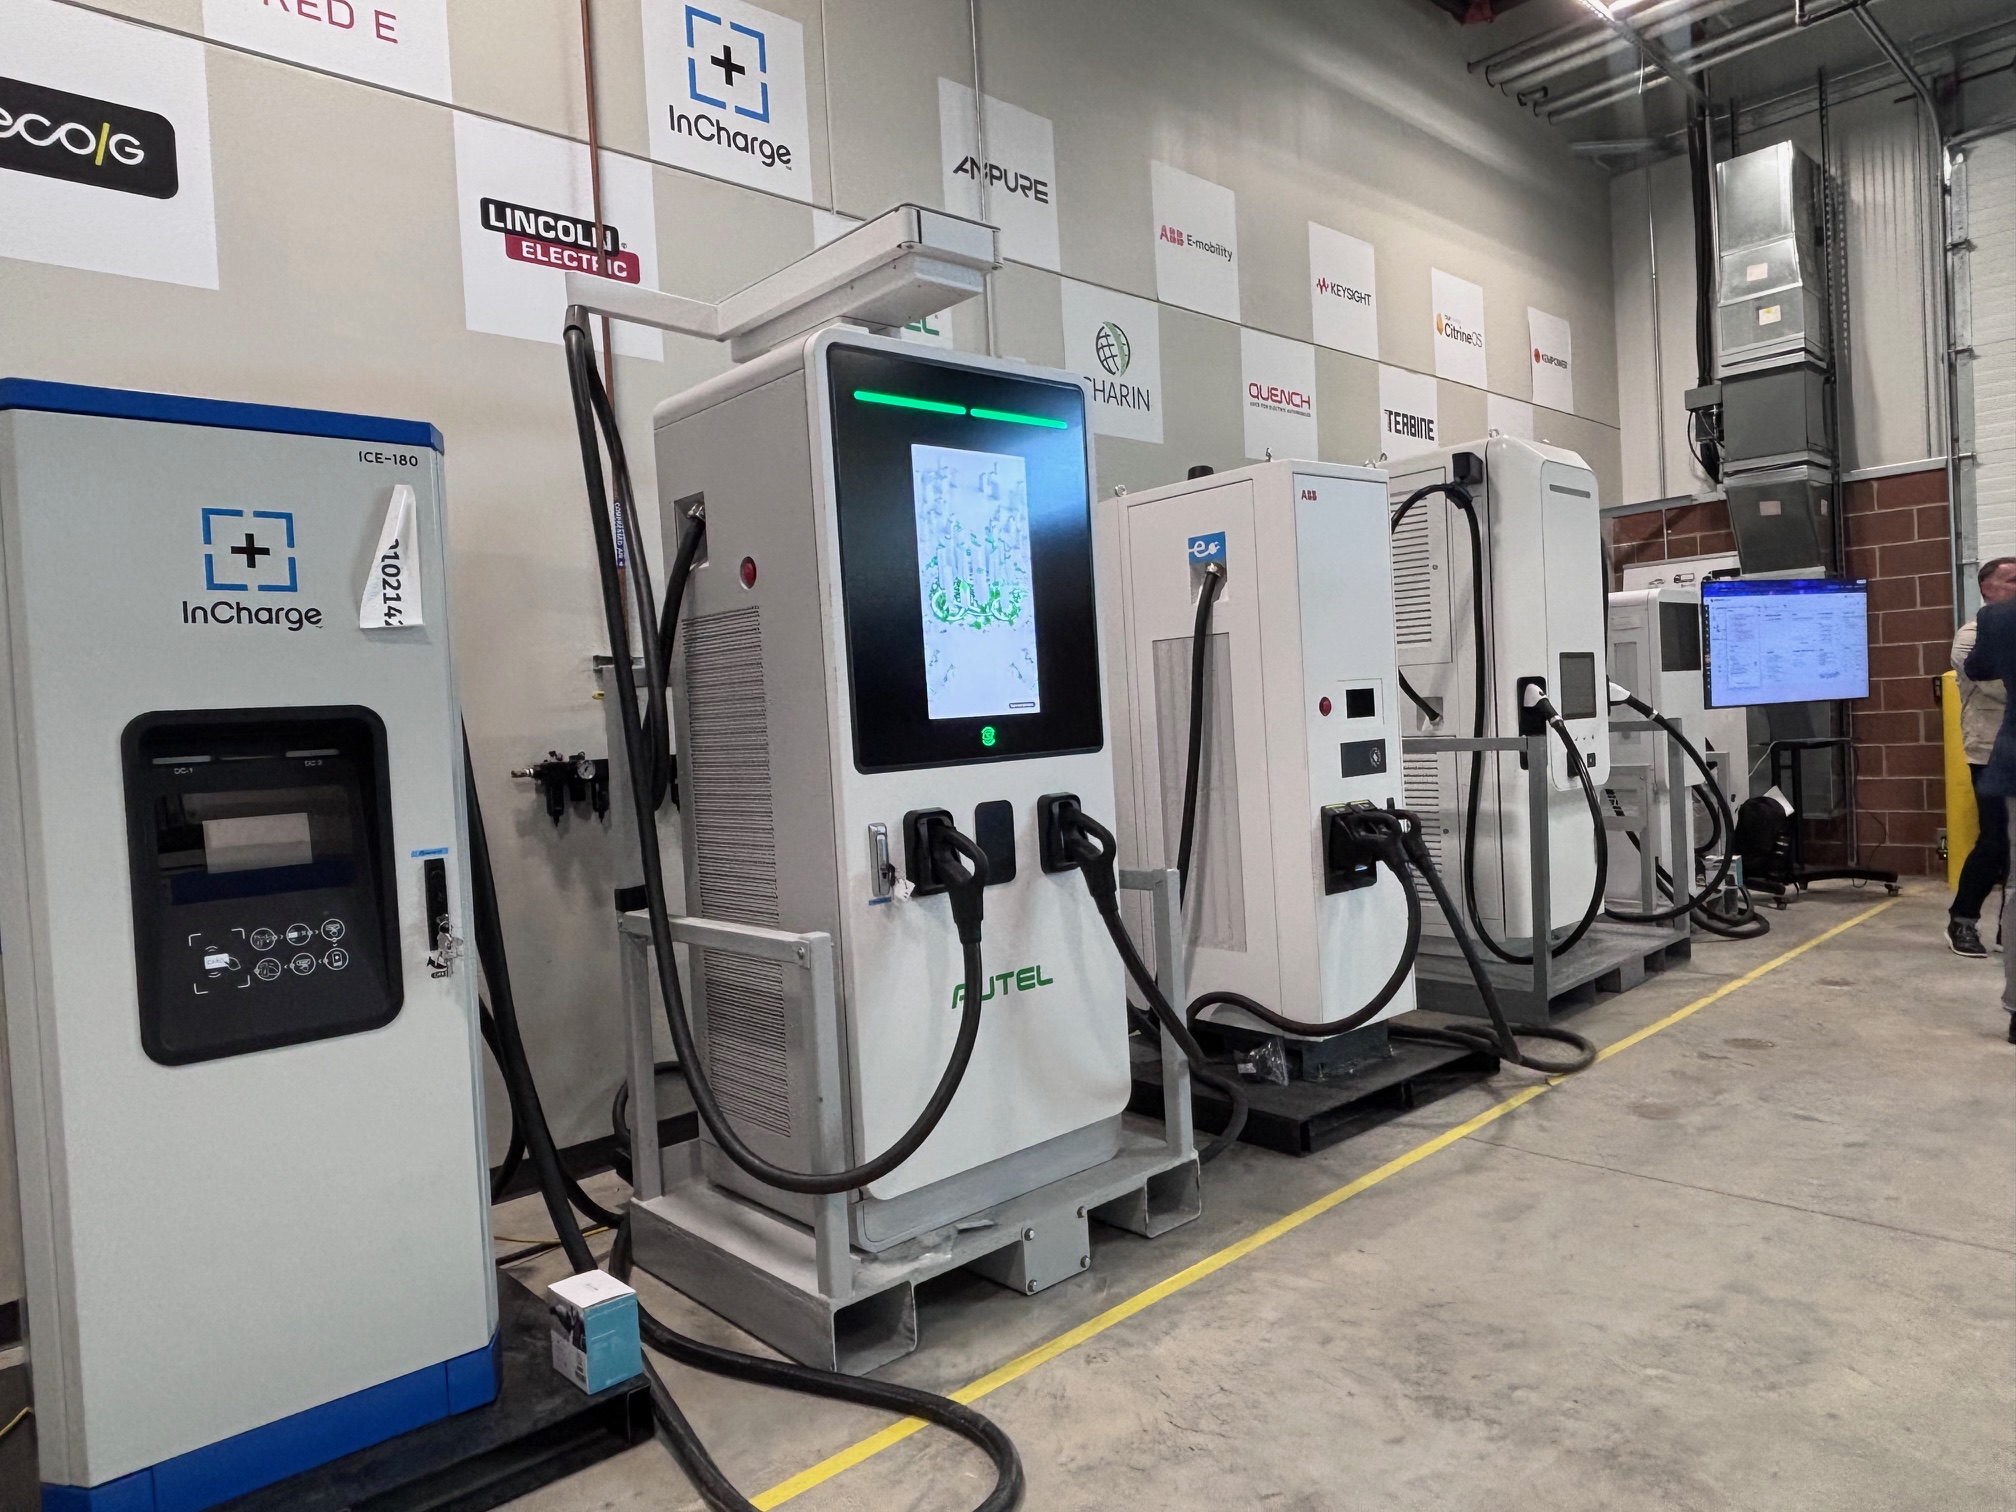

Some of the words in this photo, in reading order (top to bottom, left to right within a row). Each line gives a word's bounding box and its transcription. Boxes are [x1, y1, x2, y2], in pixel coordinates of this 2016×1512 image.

[263, 0, 355, 30] ED
[374, 9, 399, 44] E
[668, 104, 792, 168] InCharge
[1160, 224, 1184, 247] ABB
[1186, 233, 1234, 263] E-mobility
[1330, 281, 1372, 307] KEYSIGHT
[1083, 376, 1151, 412] HARIN
[1248, 382, 1311, 410] QUENCH
[358, 450, 418, 467] ICE-180
[182, 600, 323, 631] InCharge
